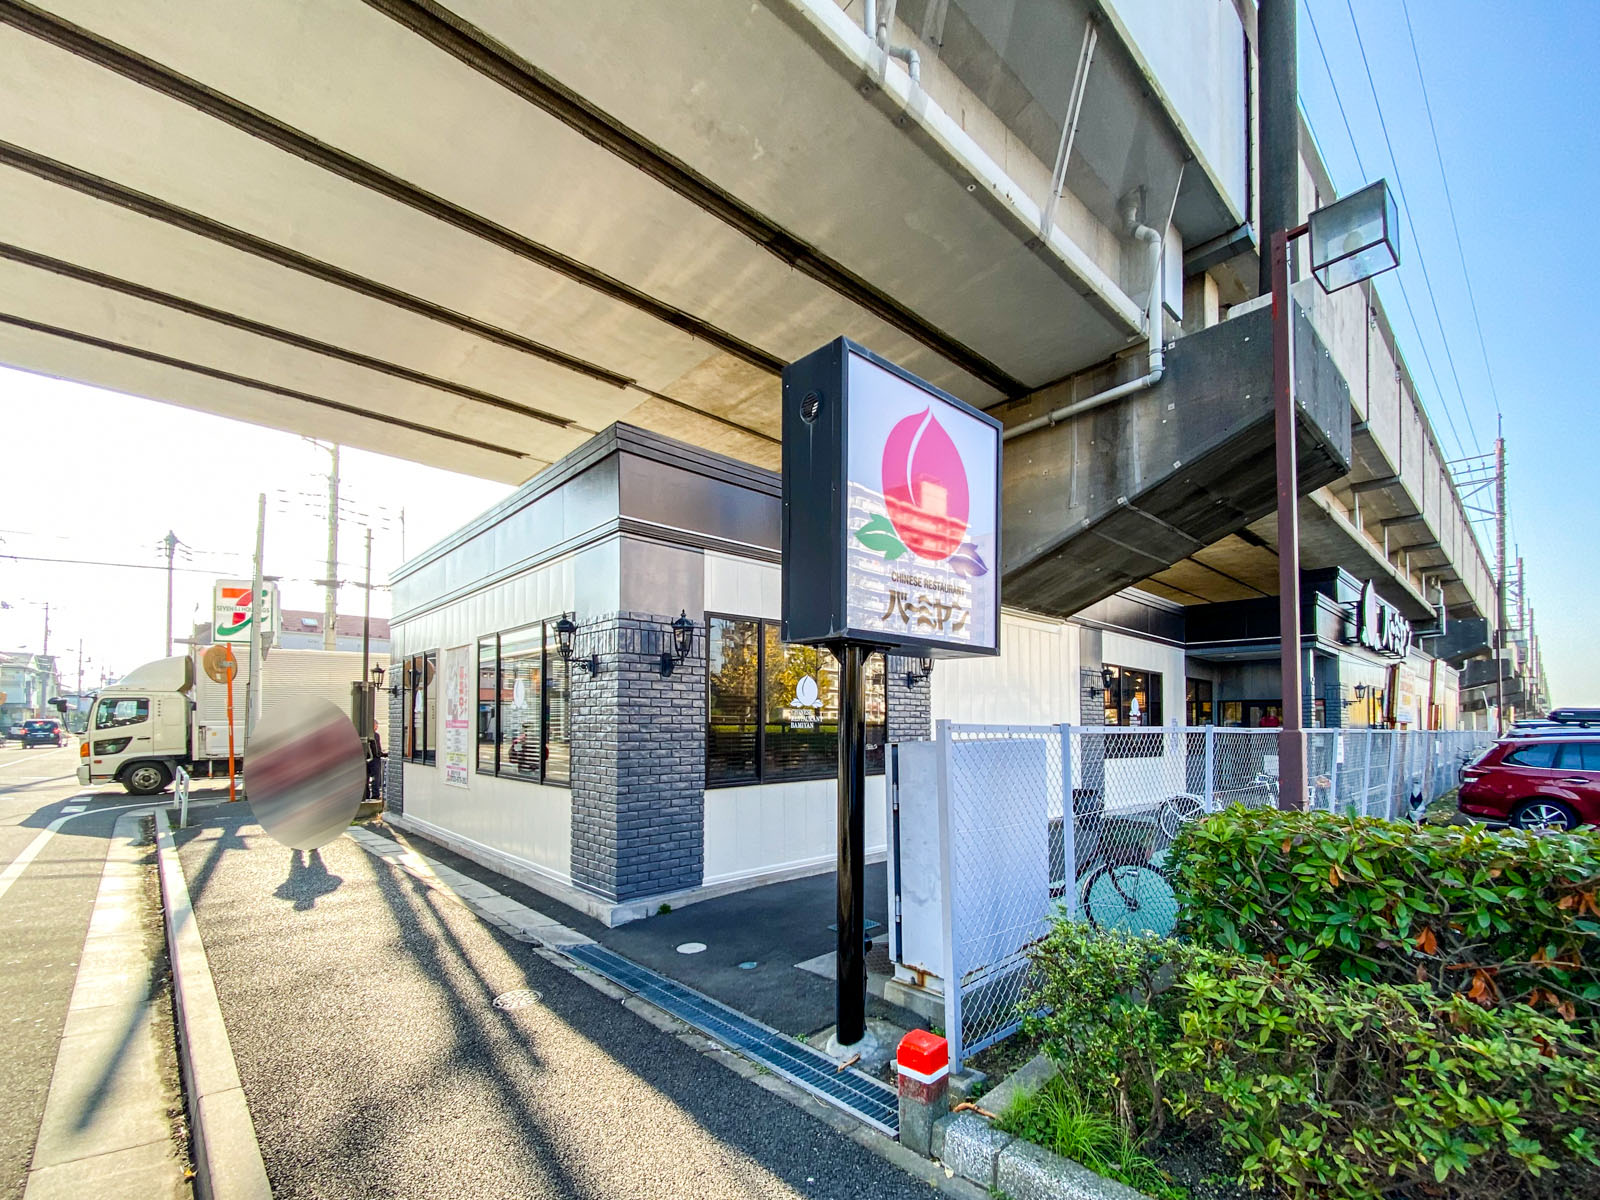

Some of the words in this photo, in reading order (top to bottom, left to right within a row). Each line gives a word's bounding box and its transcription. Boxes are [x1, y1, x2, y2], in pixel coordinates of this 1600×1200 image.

[891, 571, 923, 588] CHINESE
[923, 579, 965, 596] RESTAURANT
[881, 589, 970, 632] バーミヤン
